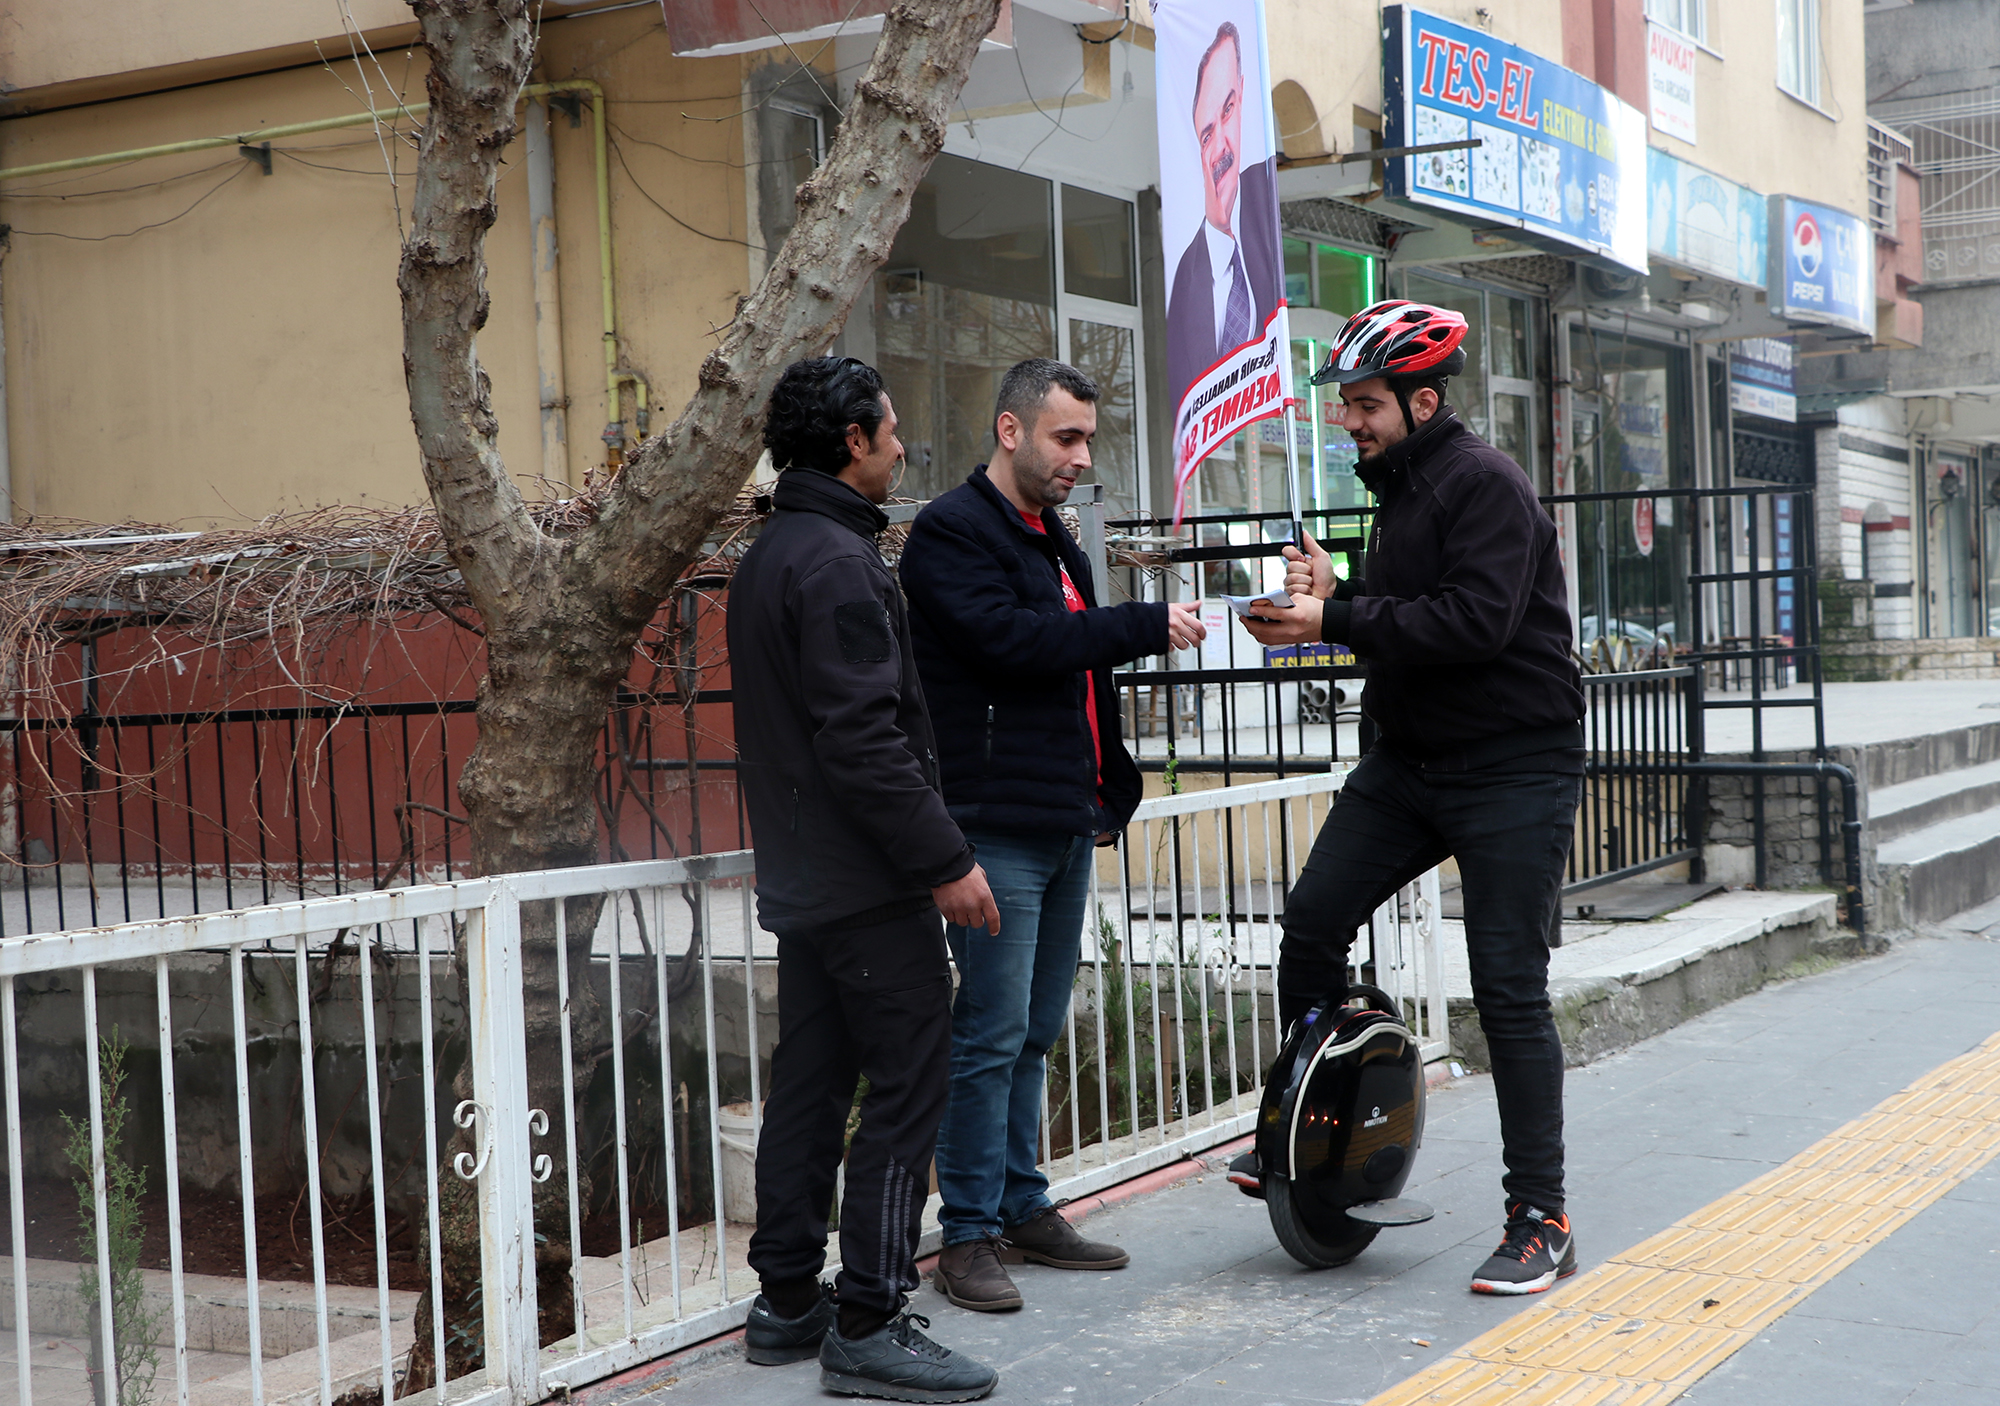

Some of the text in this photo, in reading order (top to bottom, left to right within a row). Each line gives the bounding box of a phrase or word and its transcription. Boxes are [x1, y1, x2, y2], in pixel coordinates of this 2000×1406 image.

[1650, 32, 1694, 76] AVUKAT
[1418, 28, 1539, 130] TES-EL
[1543, 98, 1587, 149] ELEKTRİK
[1792, 281, 1824, 303] PEPSI
